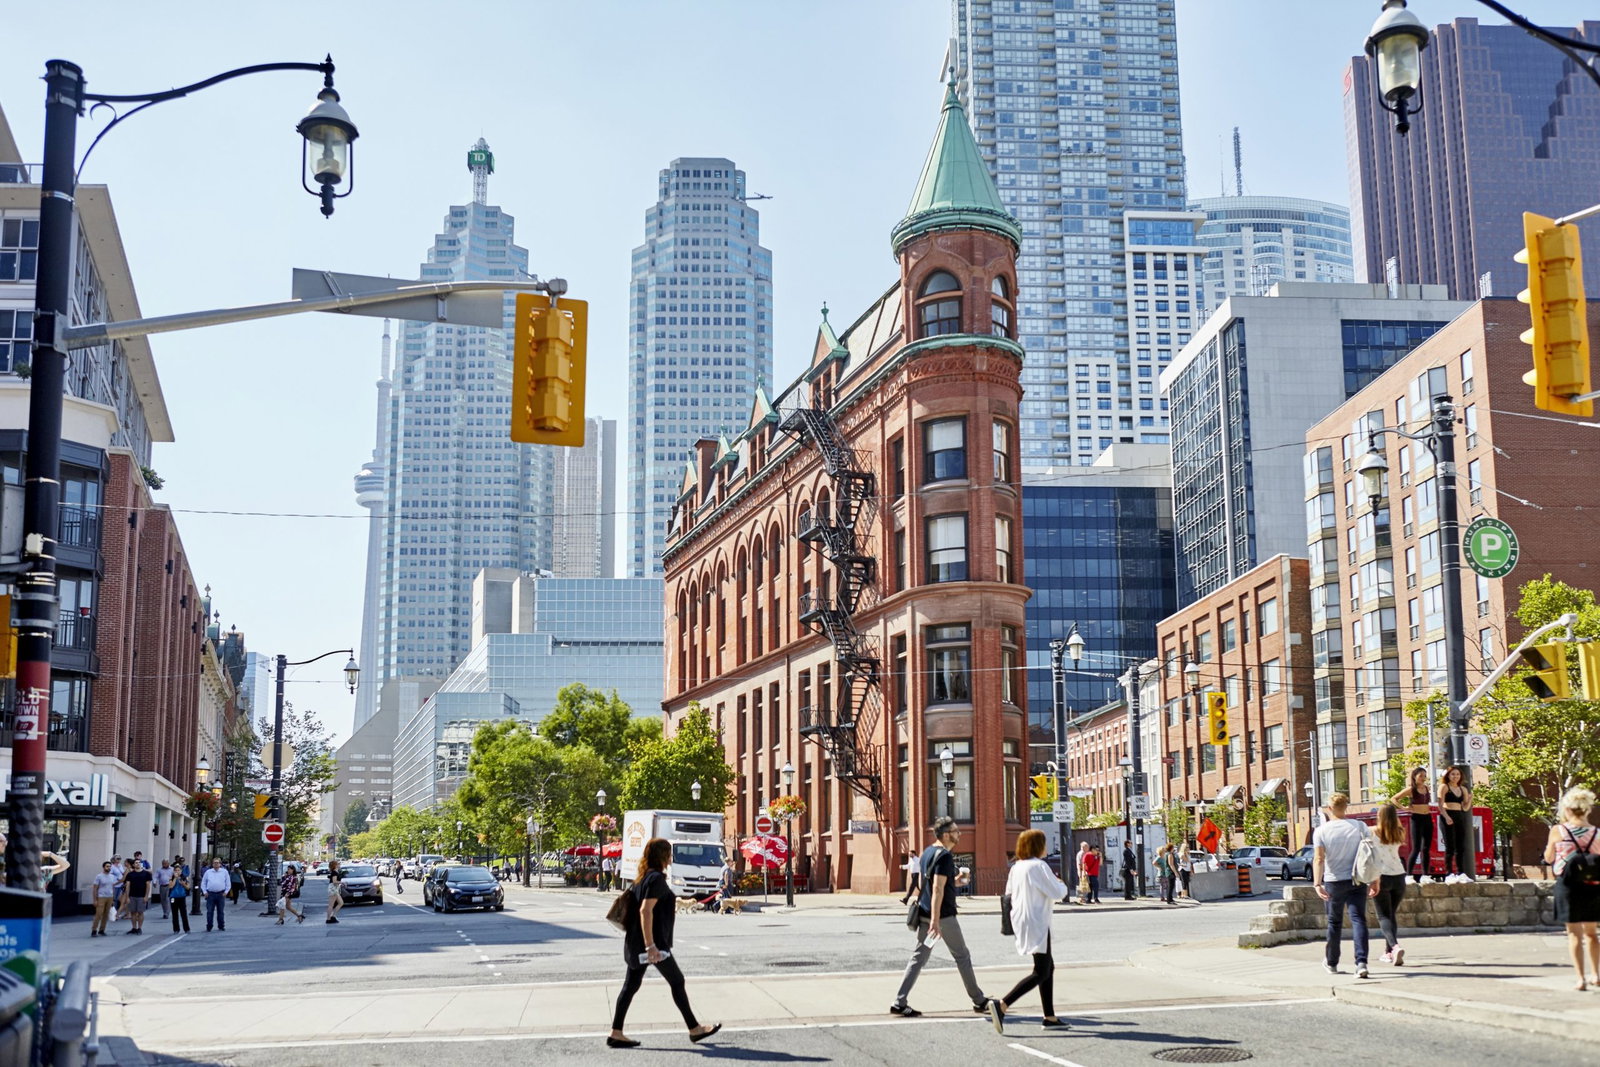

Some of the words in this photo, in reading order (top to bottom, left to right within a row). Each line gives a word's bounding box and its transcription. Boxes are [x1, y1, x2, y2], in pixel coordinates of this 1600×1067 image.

[473, 152, 486, 162] TD
[1464, 520, 1516, 547] MUNICIPAL
[1480, 533, 1503, 557] P
[1465, 552, 1516, 576] PARKING
